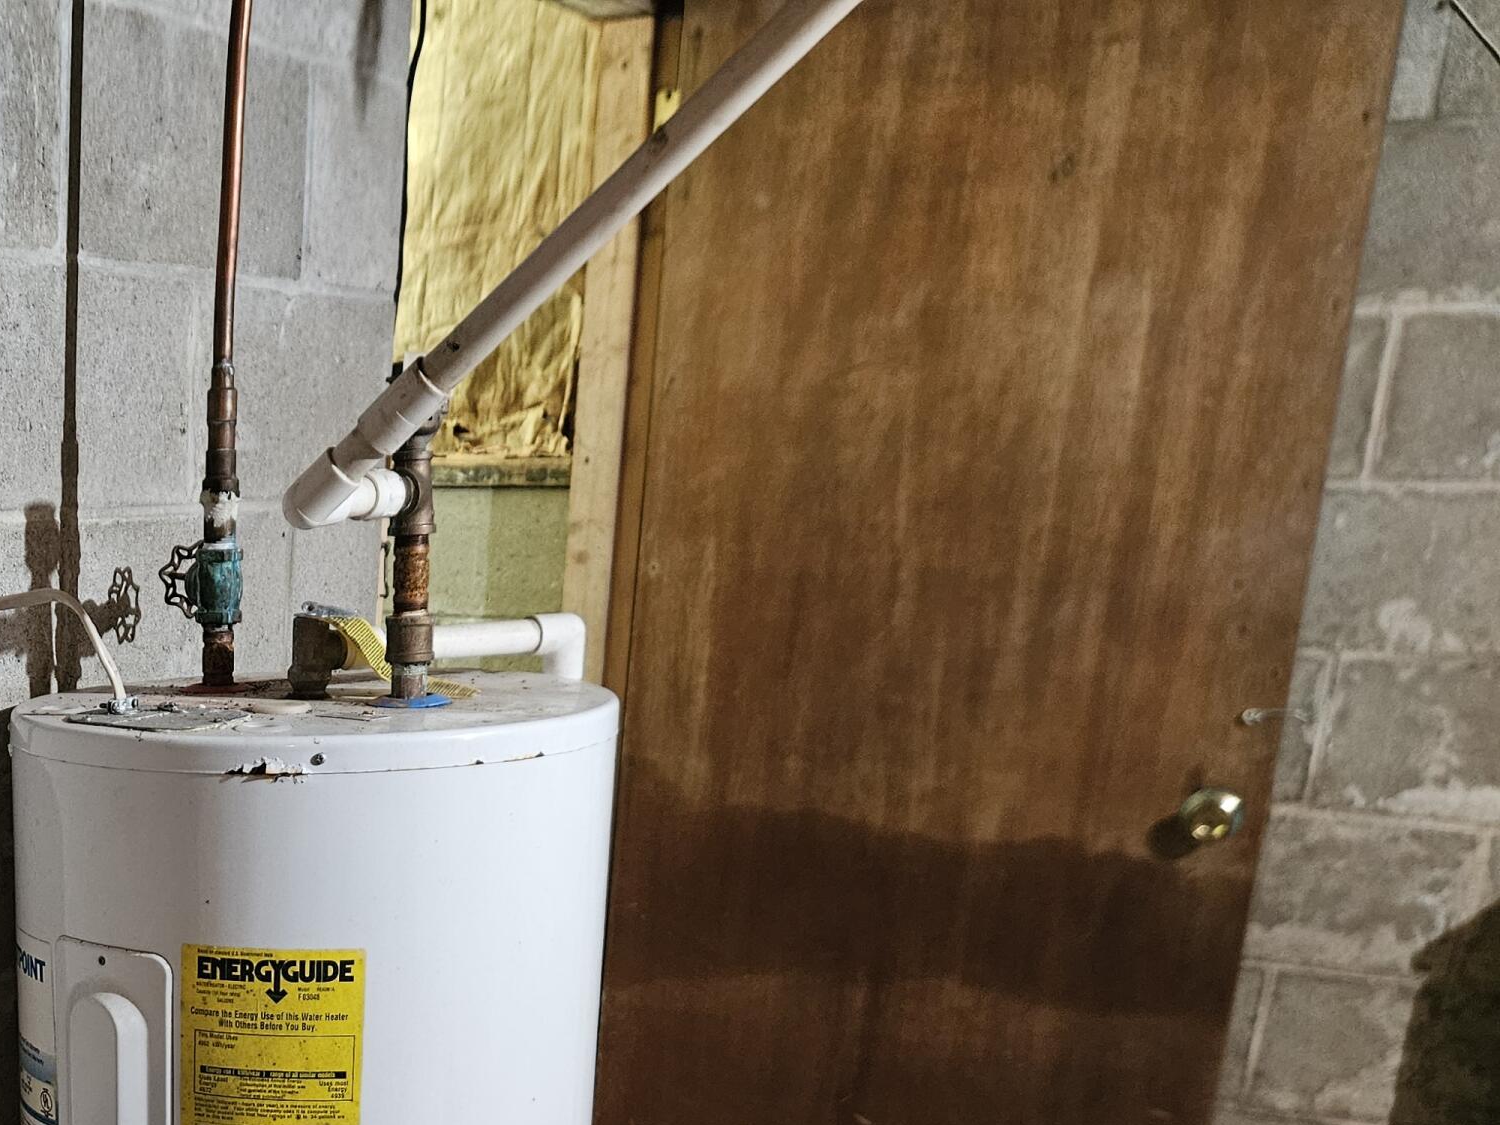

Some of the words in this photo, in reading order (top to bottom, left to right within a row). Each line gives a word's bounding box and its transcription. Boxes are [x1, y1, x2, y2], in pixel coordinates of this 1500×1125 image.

[197, 956, 355, 983] ENERGYGUIDE
[190, 1006, 220, 1017] Compare
[222, 1009, 232, 1018] the
[235, 1010, 258, 1021] Energy
[261, 1011, 274, 1020] Use
[276, 1012, 284, 1020] of
[286, 1013, 299, 1021] this
[301, 1013, 323, 1021] Water
[325, 1013, 349, 1021] Heater
[219, 1020, 233, 1028] With
[235, 1020, 257, 1029] Others
[260, 1021, 283, 1030] Before
[286, 1022, 299, 1031] You
[302, 1023, 317, 1032] Buy.
